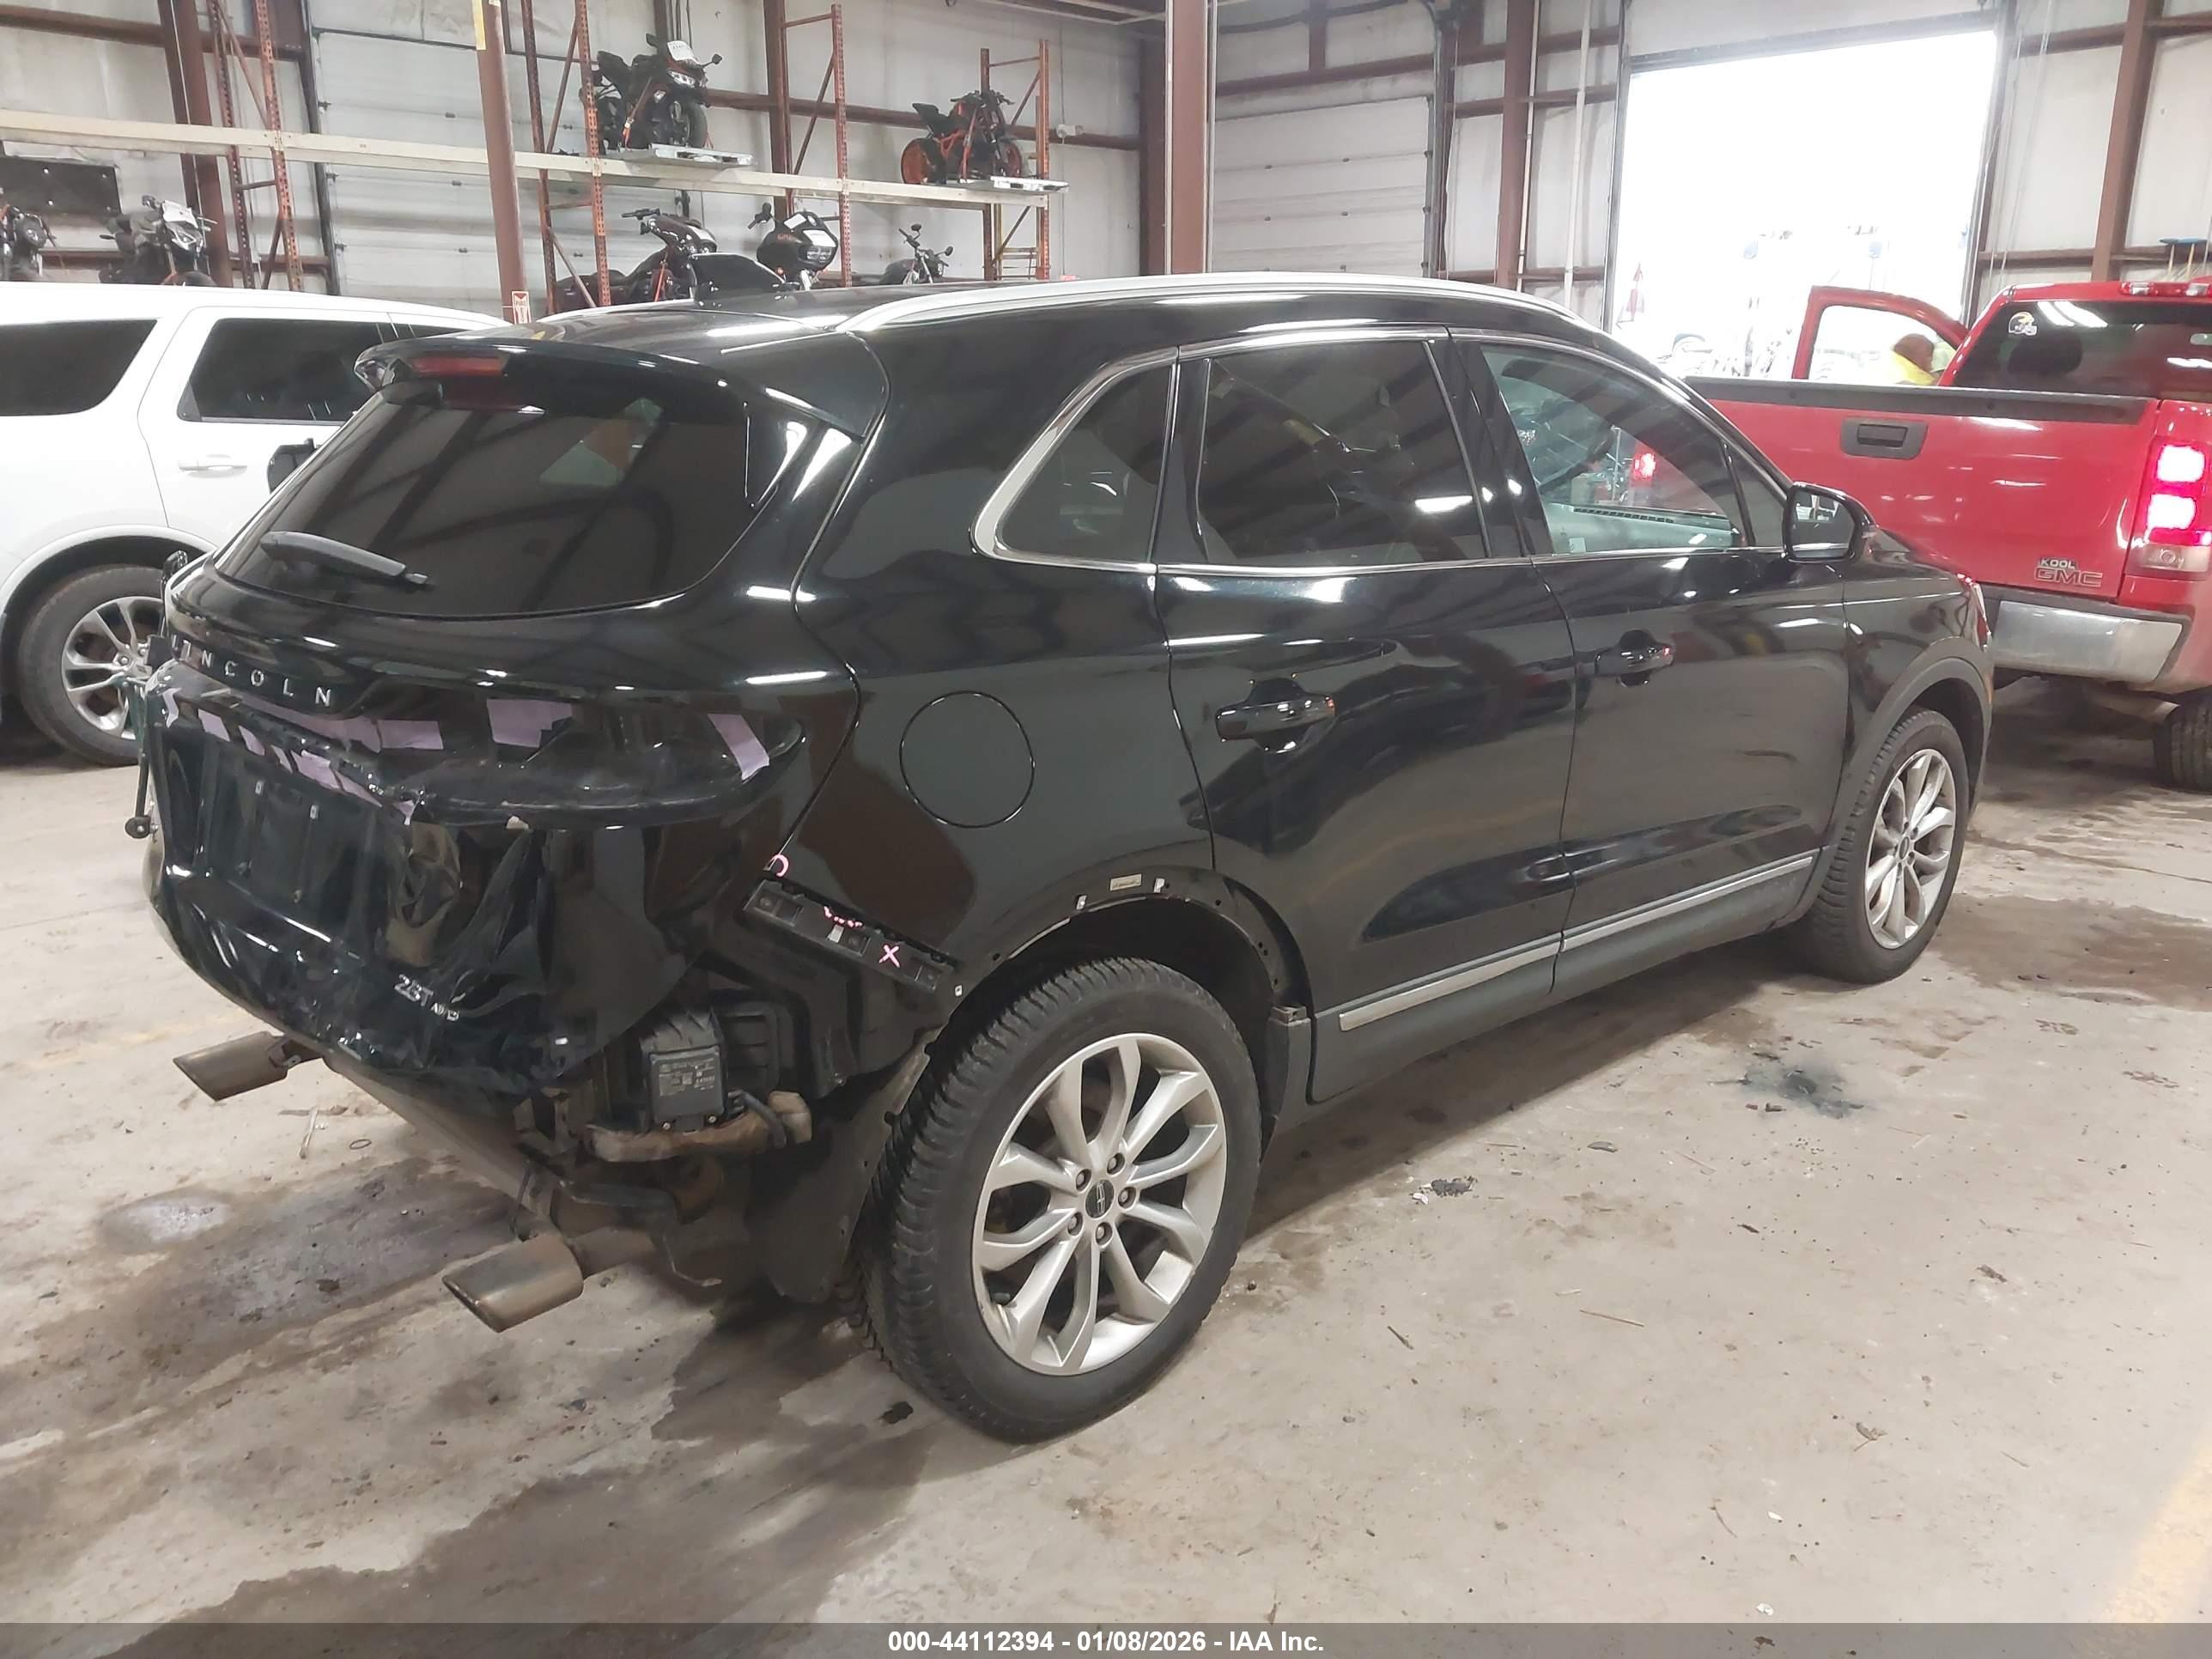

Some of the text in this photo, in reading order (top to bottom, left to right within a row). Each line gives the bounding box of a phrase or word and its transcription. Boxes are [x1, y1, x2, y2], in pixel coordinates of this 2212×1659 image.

[2040, 559, 2075, 569] KOOL
[2033, 567, 2103, 588] GMC
[171, 635, 332, 708] LINCOLN
